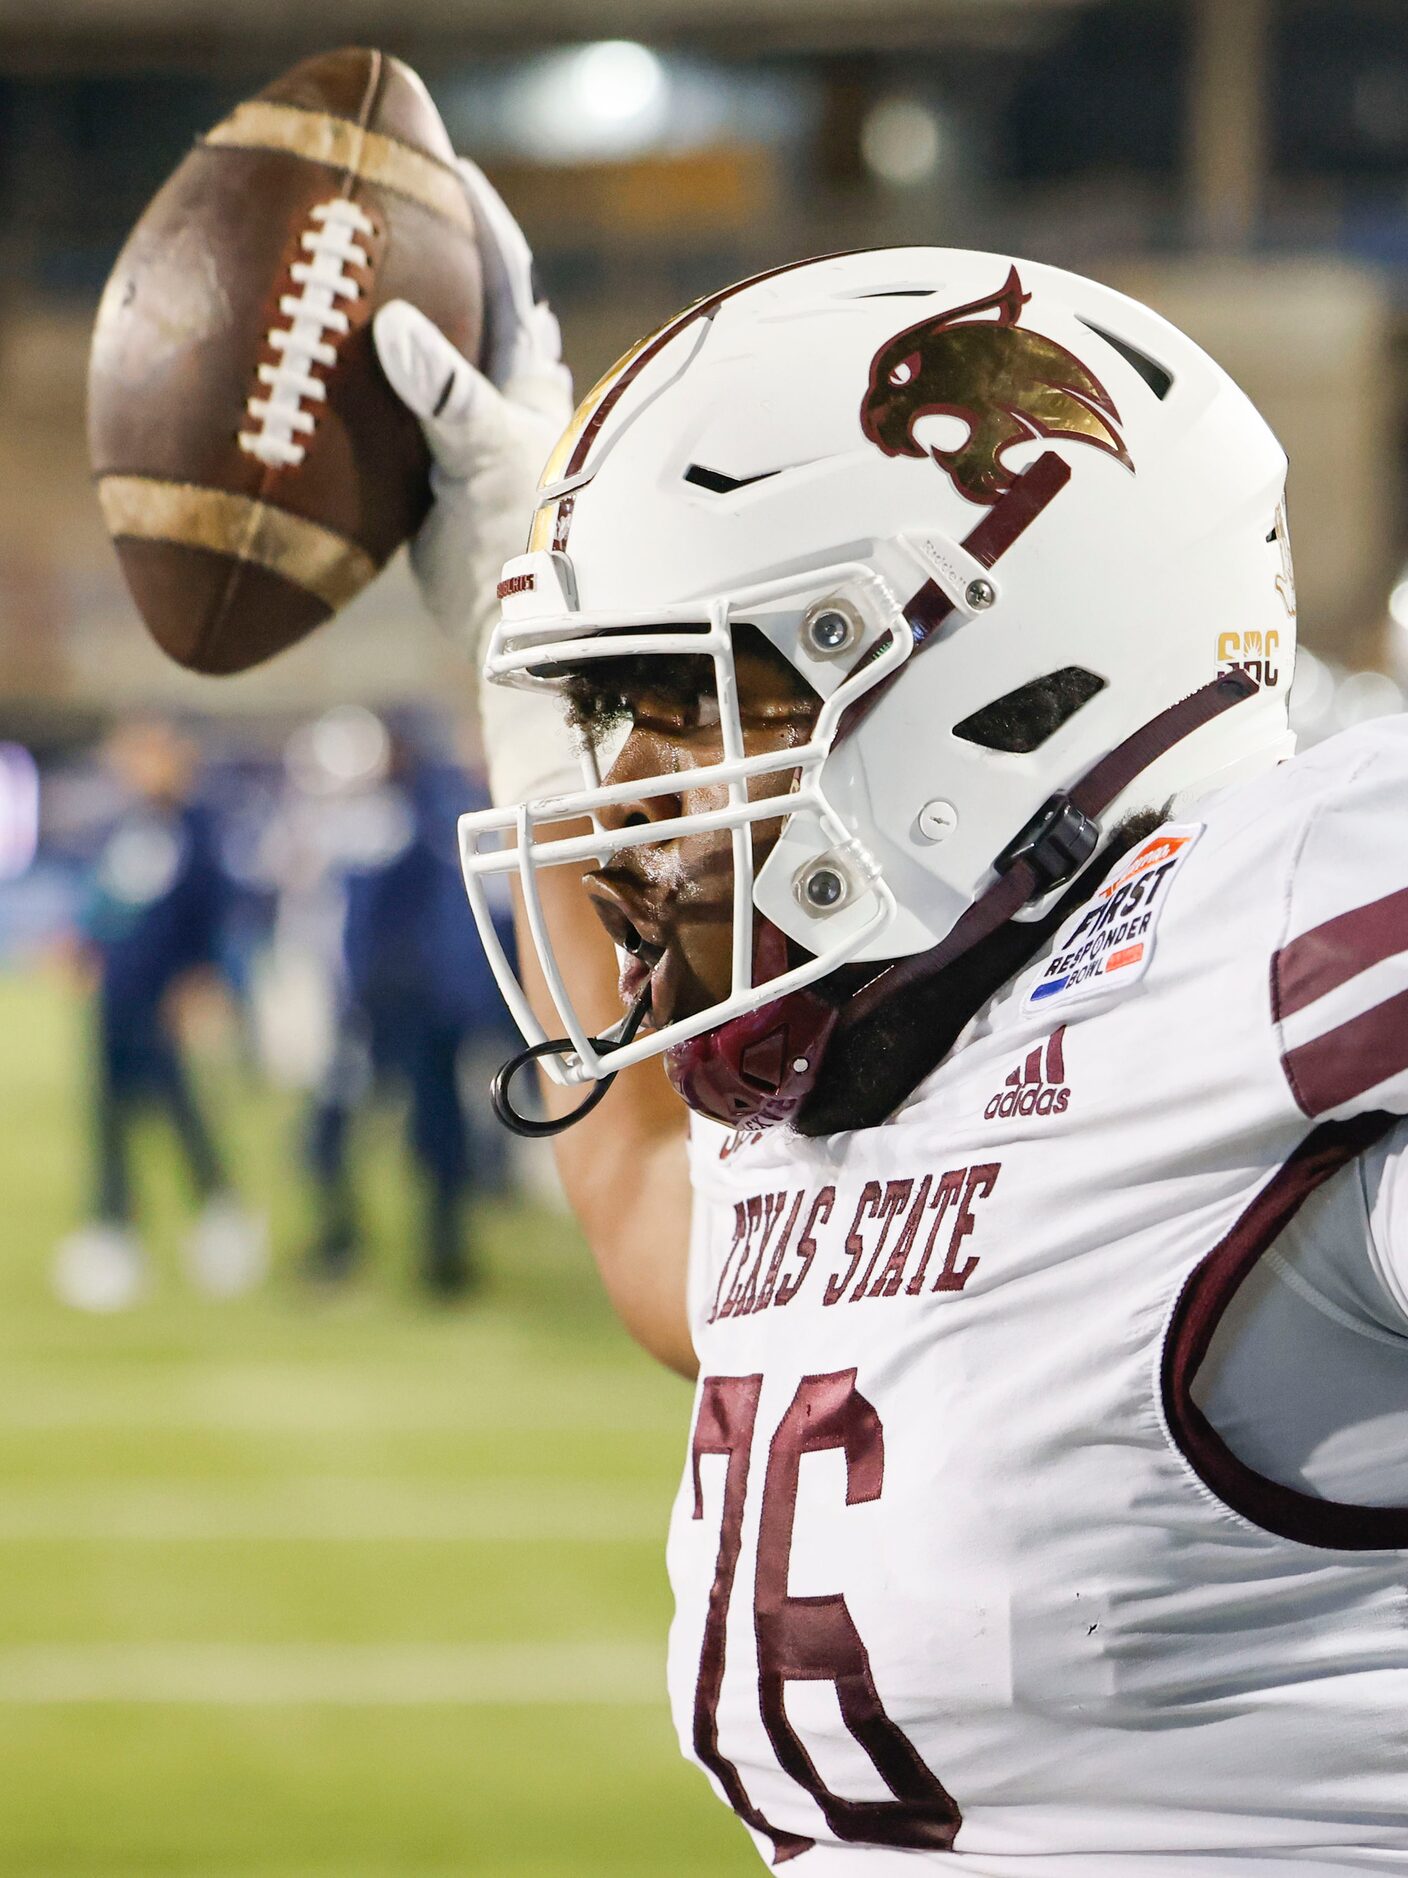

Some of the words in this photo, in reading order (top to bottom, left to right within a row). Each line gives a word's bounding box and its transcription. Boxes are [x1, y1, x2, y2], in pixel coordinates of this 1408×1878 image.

[1217, 629, 1279, 687] SBC
[1062, 857, 1178, 950] FIRST
[1044, 911, 1153, 978] RESPONDER
[1066, 958, 1104, 989] BOWL
[984, 1081, 1071, 1120] adidas
[706, 1186, 836, 1325] TEXAS
[822, 1162, 1002, 1307] STATE
[692, 1367, 963, 1865] 76
